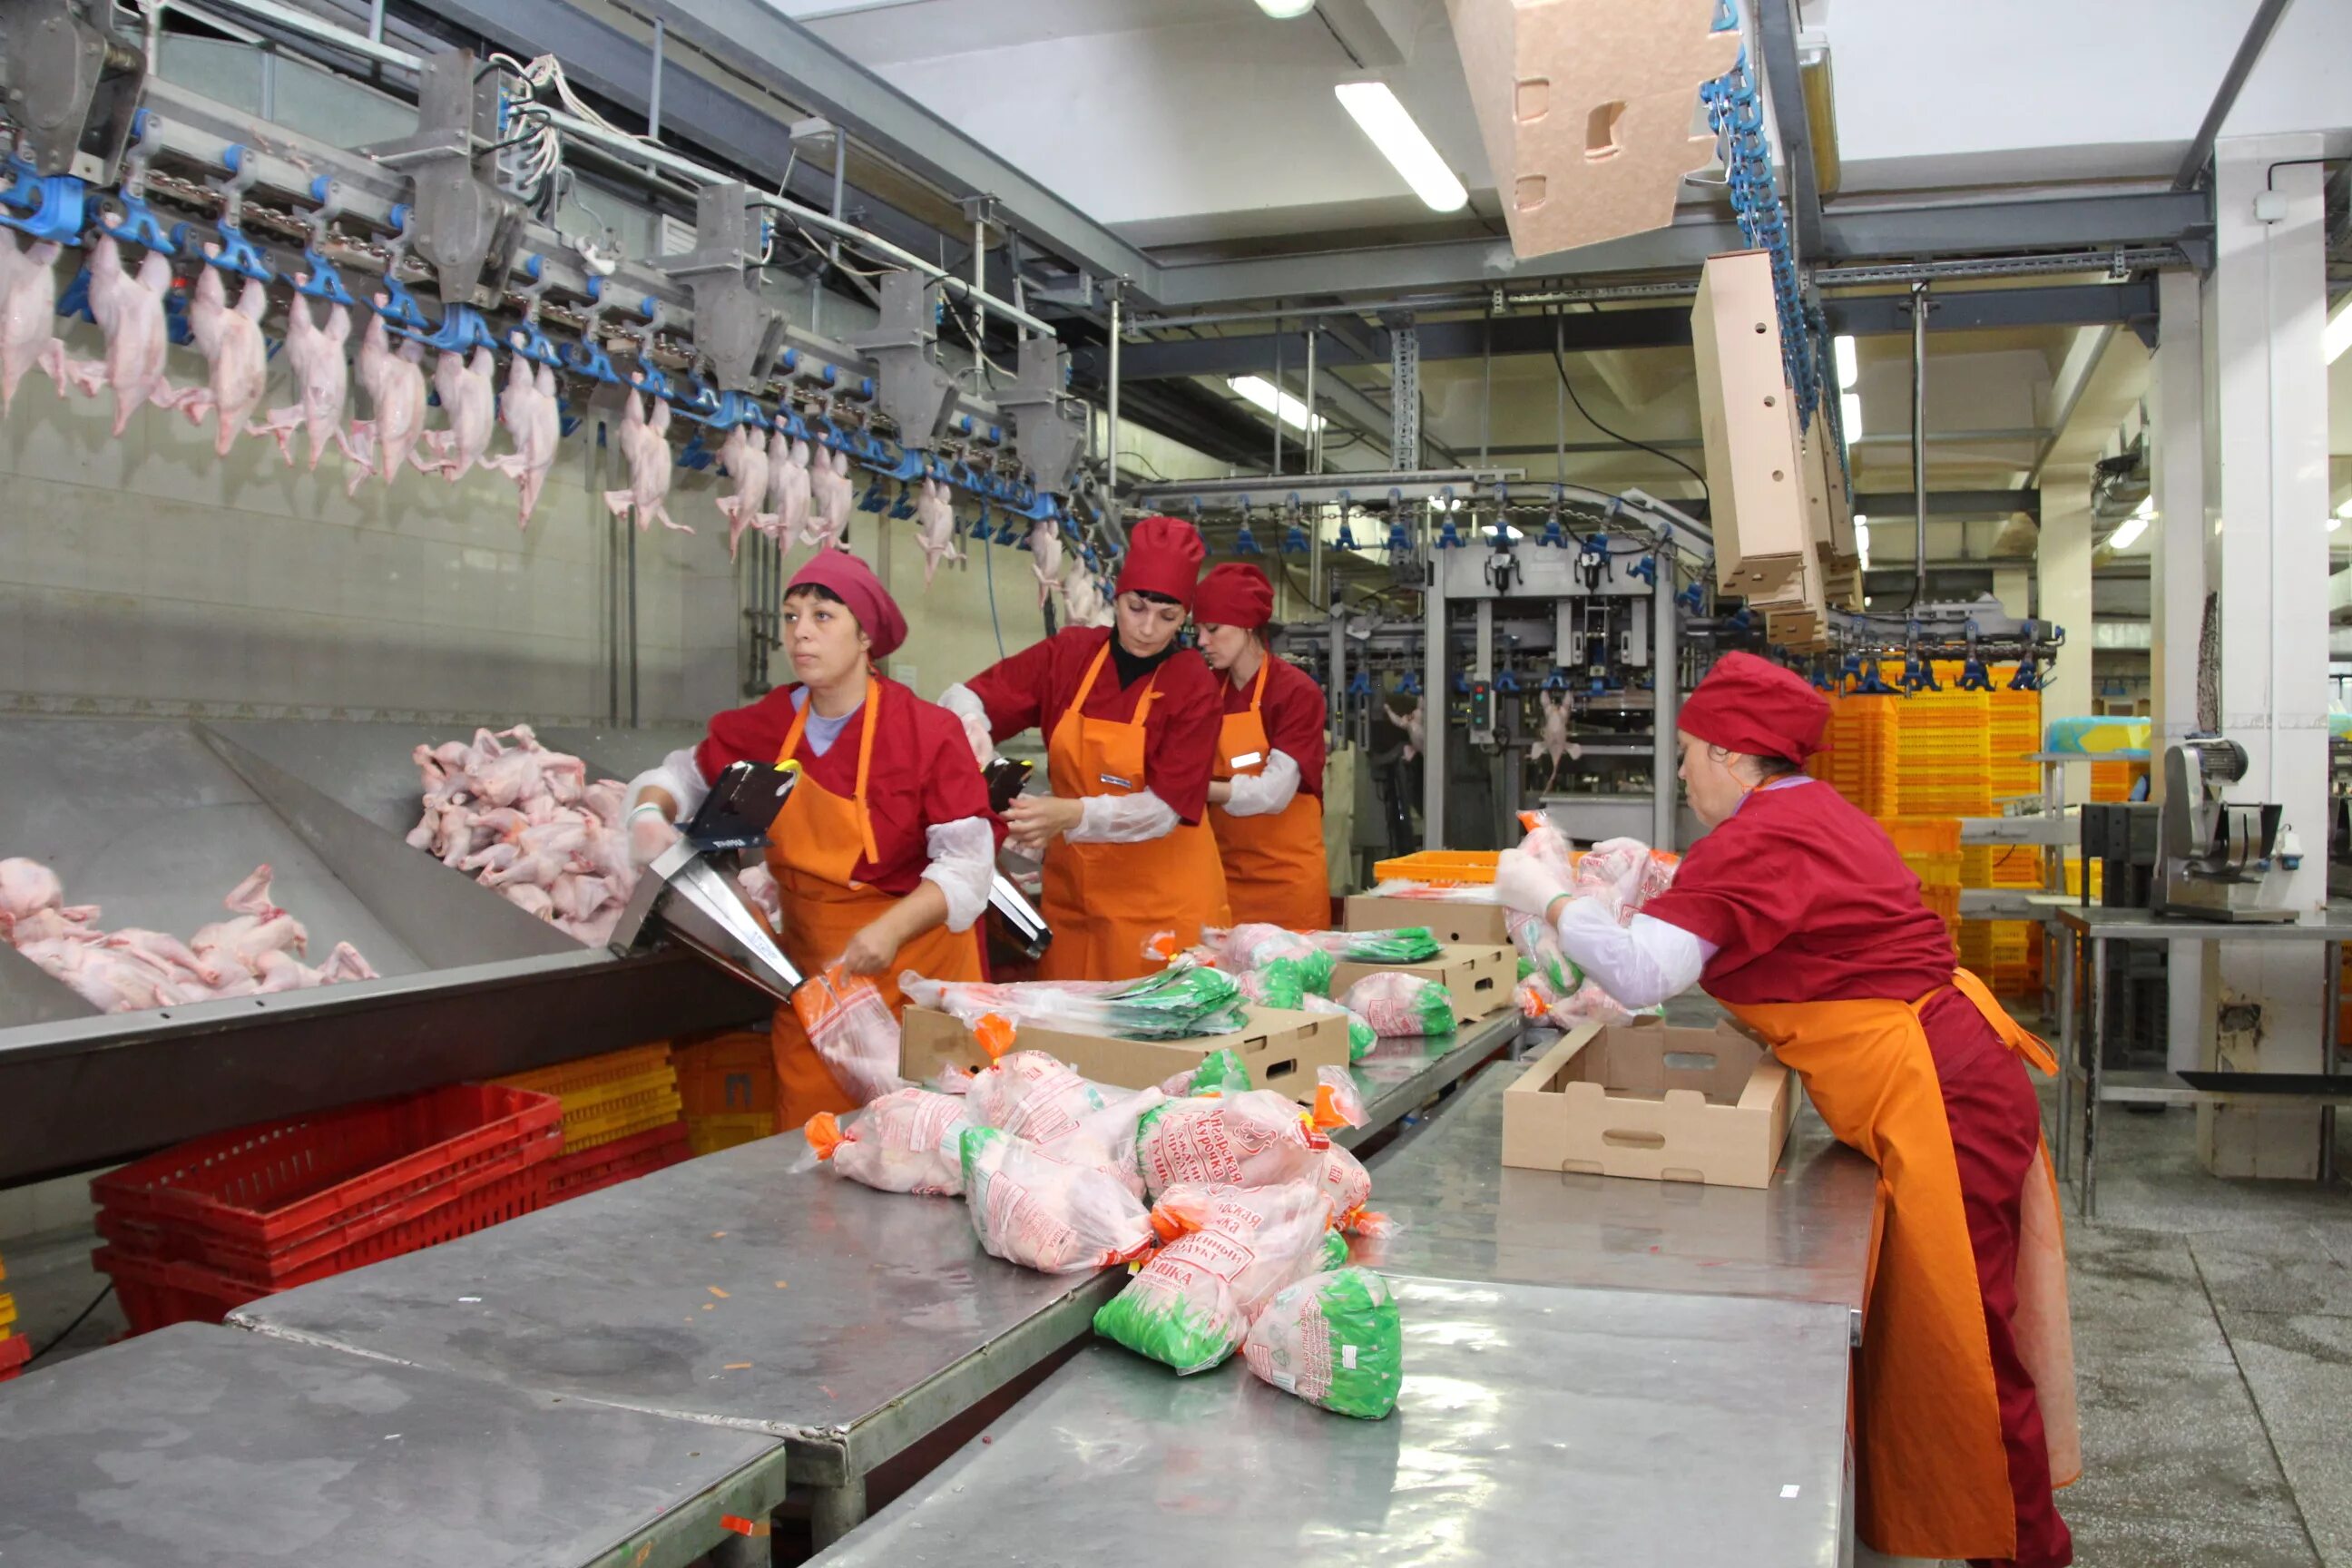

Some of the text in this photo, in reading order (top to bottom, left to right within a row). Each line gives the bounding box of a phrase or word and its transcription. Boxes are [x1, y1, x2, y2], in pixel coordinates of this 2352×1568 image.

[1151, 1138, 1170, 1188] ТУШК
[1168, 1133, 1191, 1182] ПРОДУК
[1210, 1109, 1243, 1182] Ангарская
[1145, 1259, 1193, 1286] УШКА
